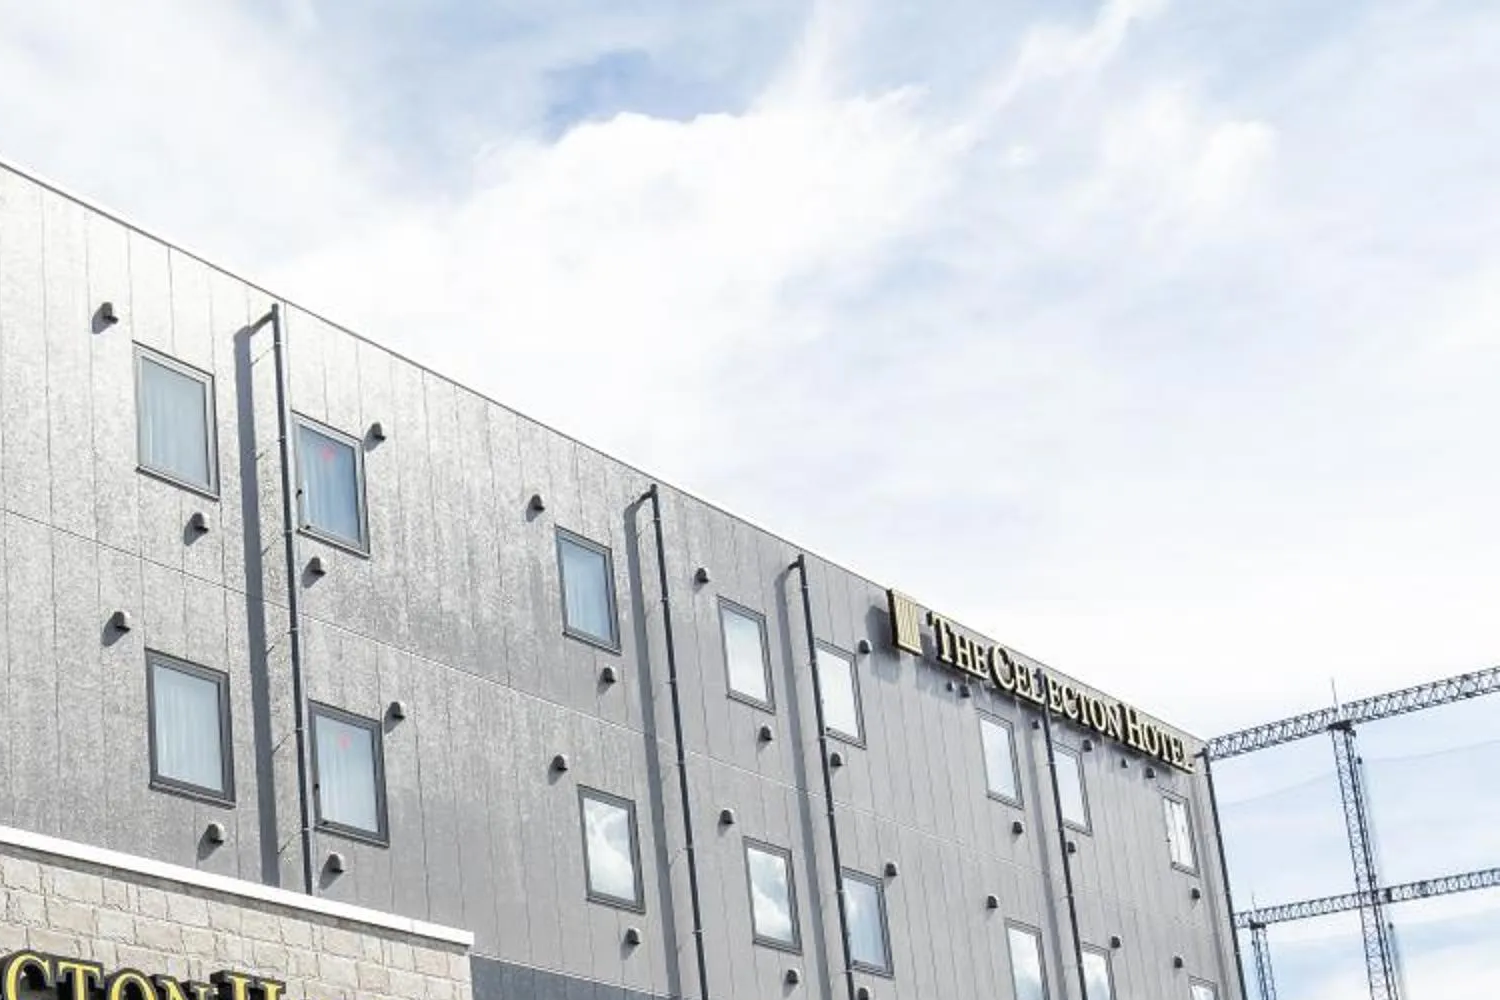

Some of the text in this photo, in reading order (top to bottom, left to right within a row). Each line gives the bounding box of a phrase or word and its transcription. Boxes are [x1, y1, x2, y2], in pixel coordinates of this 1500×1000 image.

[930, 613, 1196, 774] THE CELECTON HOTEL
